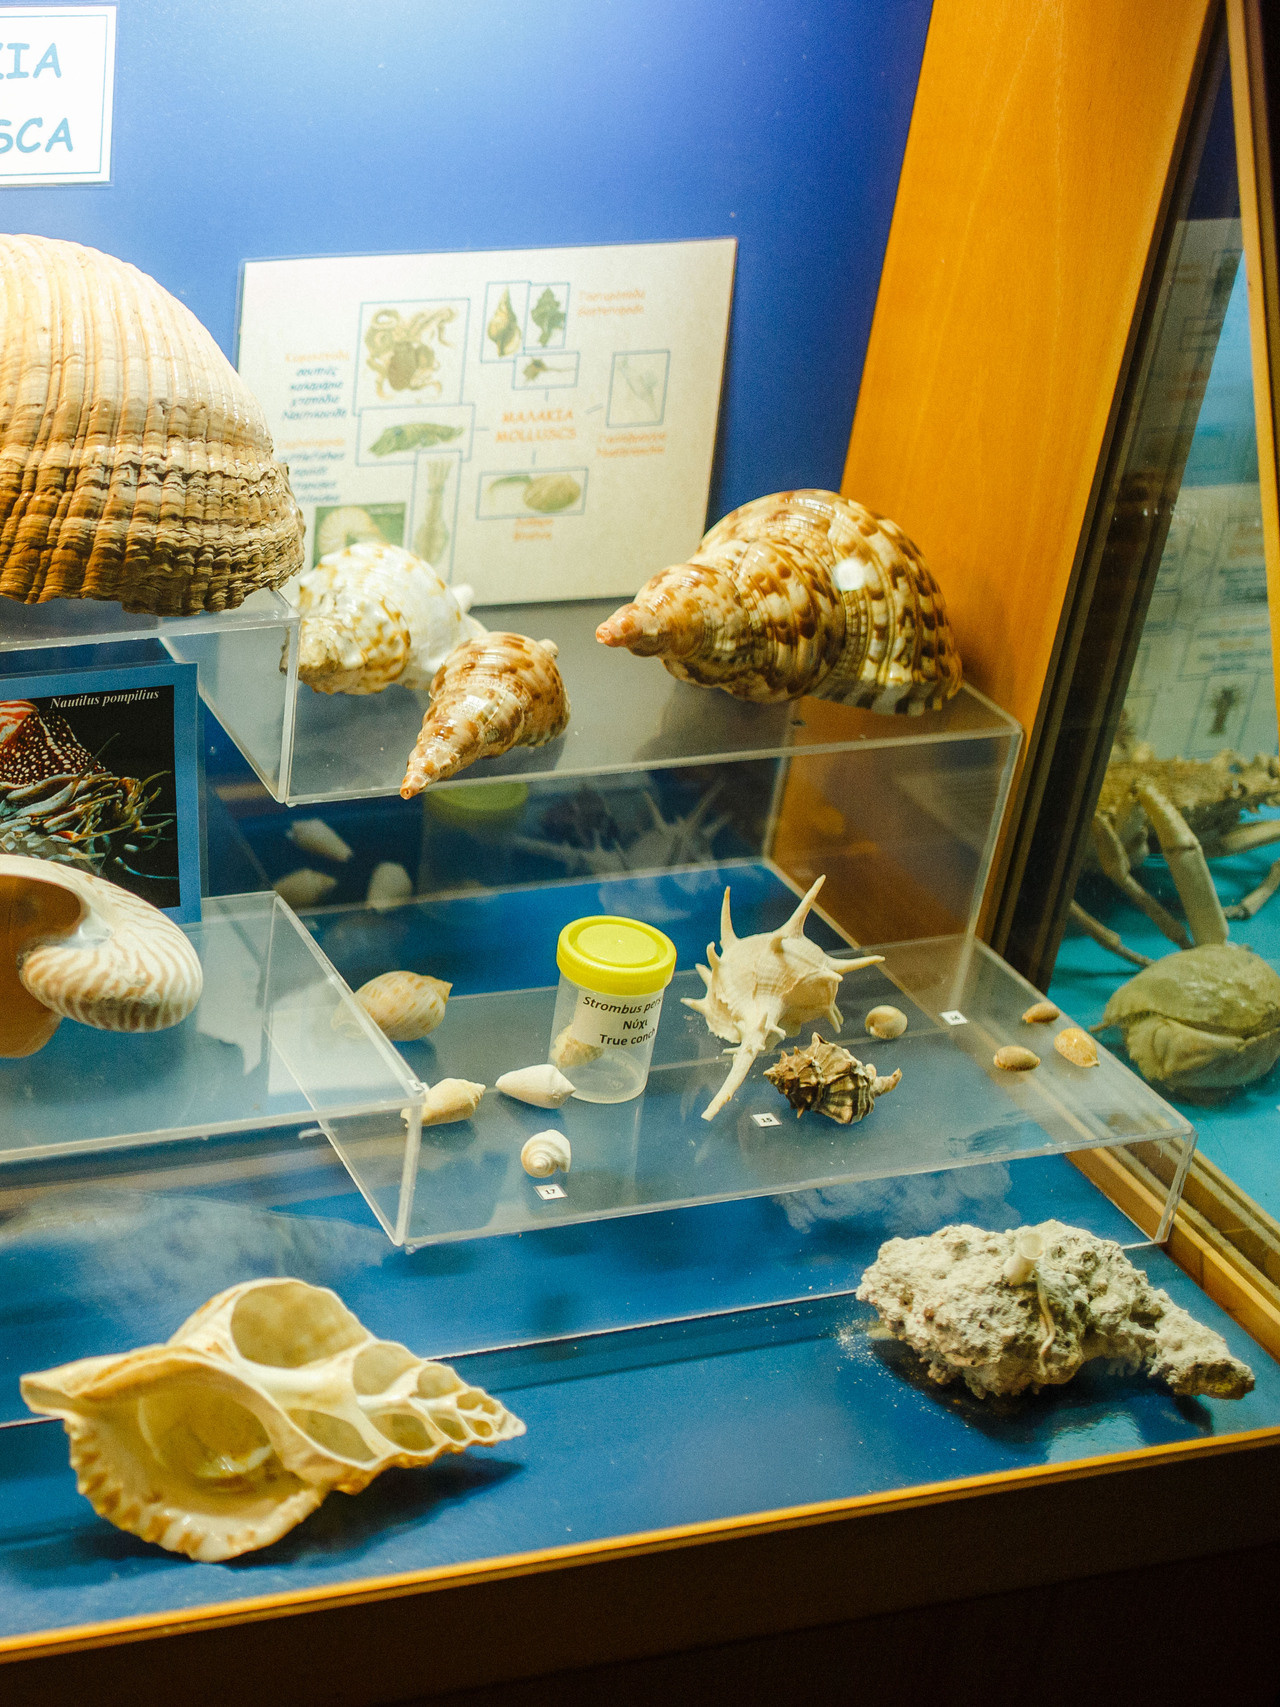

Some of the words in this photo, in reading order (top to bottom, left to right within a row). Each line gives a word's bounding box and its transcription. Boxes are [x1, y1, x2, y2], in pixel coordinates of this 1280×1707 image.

[49, 694, 101, 709] Nautilus
[101, 689, 160, 707] pompilius
[583, 996, 643, 1014] Strombus
[622, 1018, 648, 1030] Νύχι
[599, 1033, 628, 1045] True
